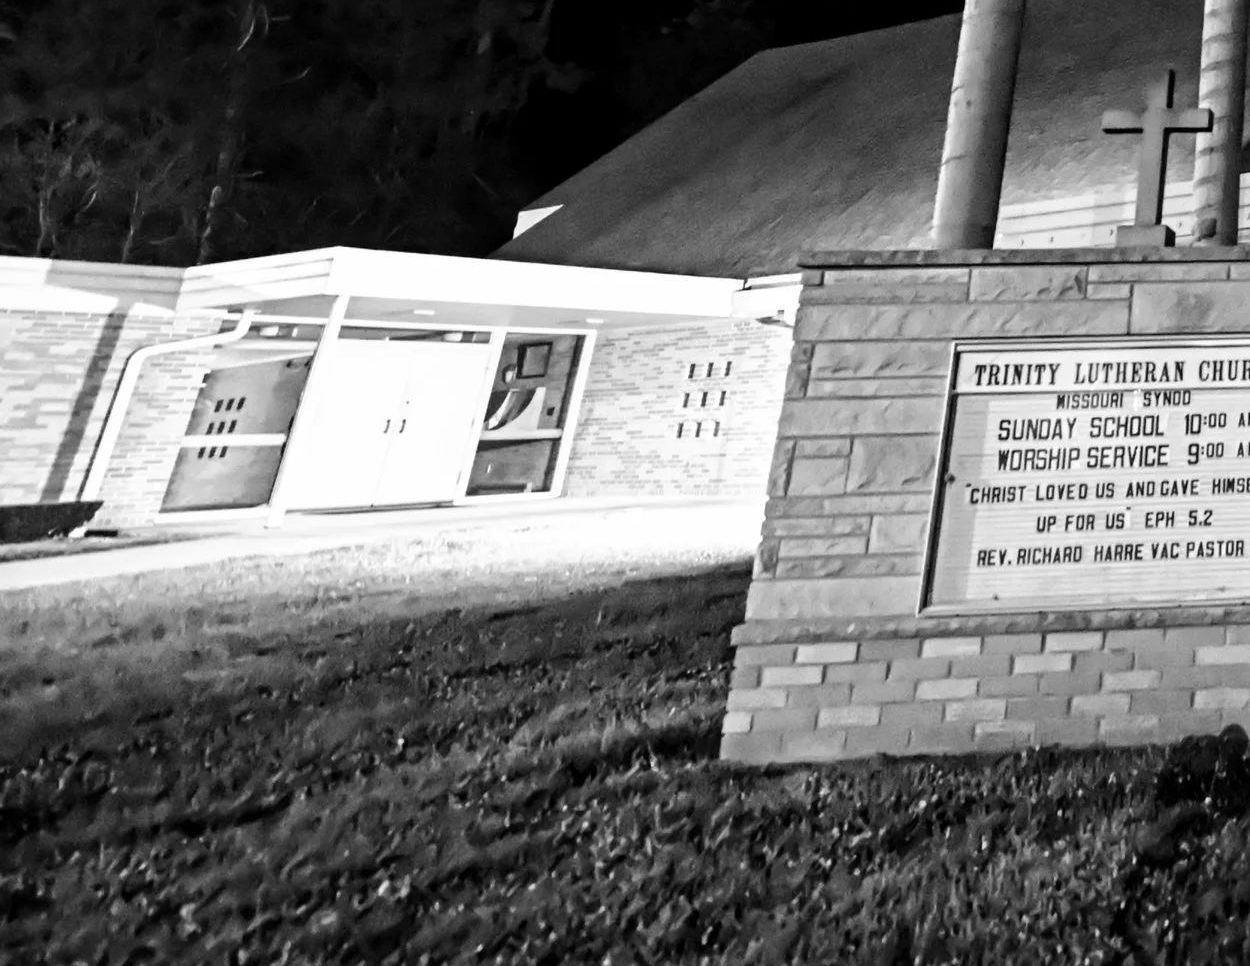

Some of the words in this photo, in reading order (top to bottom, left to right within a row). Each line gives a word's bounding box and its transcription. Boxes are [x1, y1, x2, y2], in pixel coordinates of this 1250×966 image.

[975, 362, 1061, 386] TRINITY
[1074, 361, 1186, 385] LUTHERAN
[1056, 392, 1124, 410] MISSOURI
[1143, 390, 1191, 407] SYNOD
[998, 417, 1077, 441] SUNDAY
[1089, 415, 1165, 438] SCHOOL
[1185, 413, 1227, 435] 10:00
[998, 447, 1080, 471] WORSHIP
[1087, 444, 1170, 469] SERVICE
[1187, 442, 1224, 465] 9:00
[1035, 483, 1088, 501] LOVED
[1095, 482, 1115, 499] US
[1126, 481, 1155, 498] AND
[1160, 479, 1199, 496] GAVE
[1036, 515, 1057, 533] UP
[1064, 514, 1096, 532] FOR
[1144, 511, 1175, 529] EPH
[1188, 509, 1213, 527] 5.2
[977, 549, 1012, 567] REV.
[1016, 546, 1082, 565] RICHARD
[1094, 543, 1144, 562] HARRE
[1151, 542, 1180, 560] VAC
[1186, 540, 1245, 559] PASTOR
